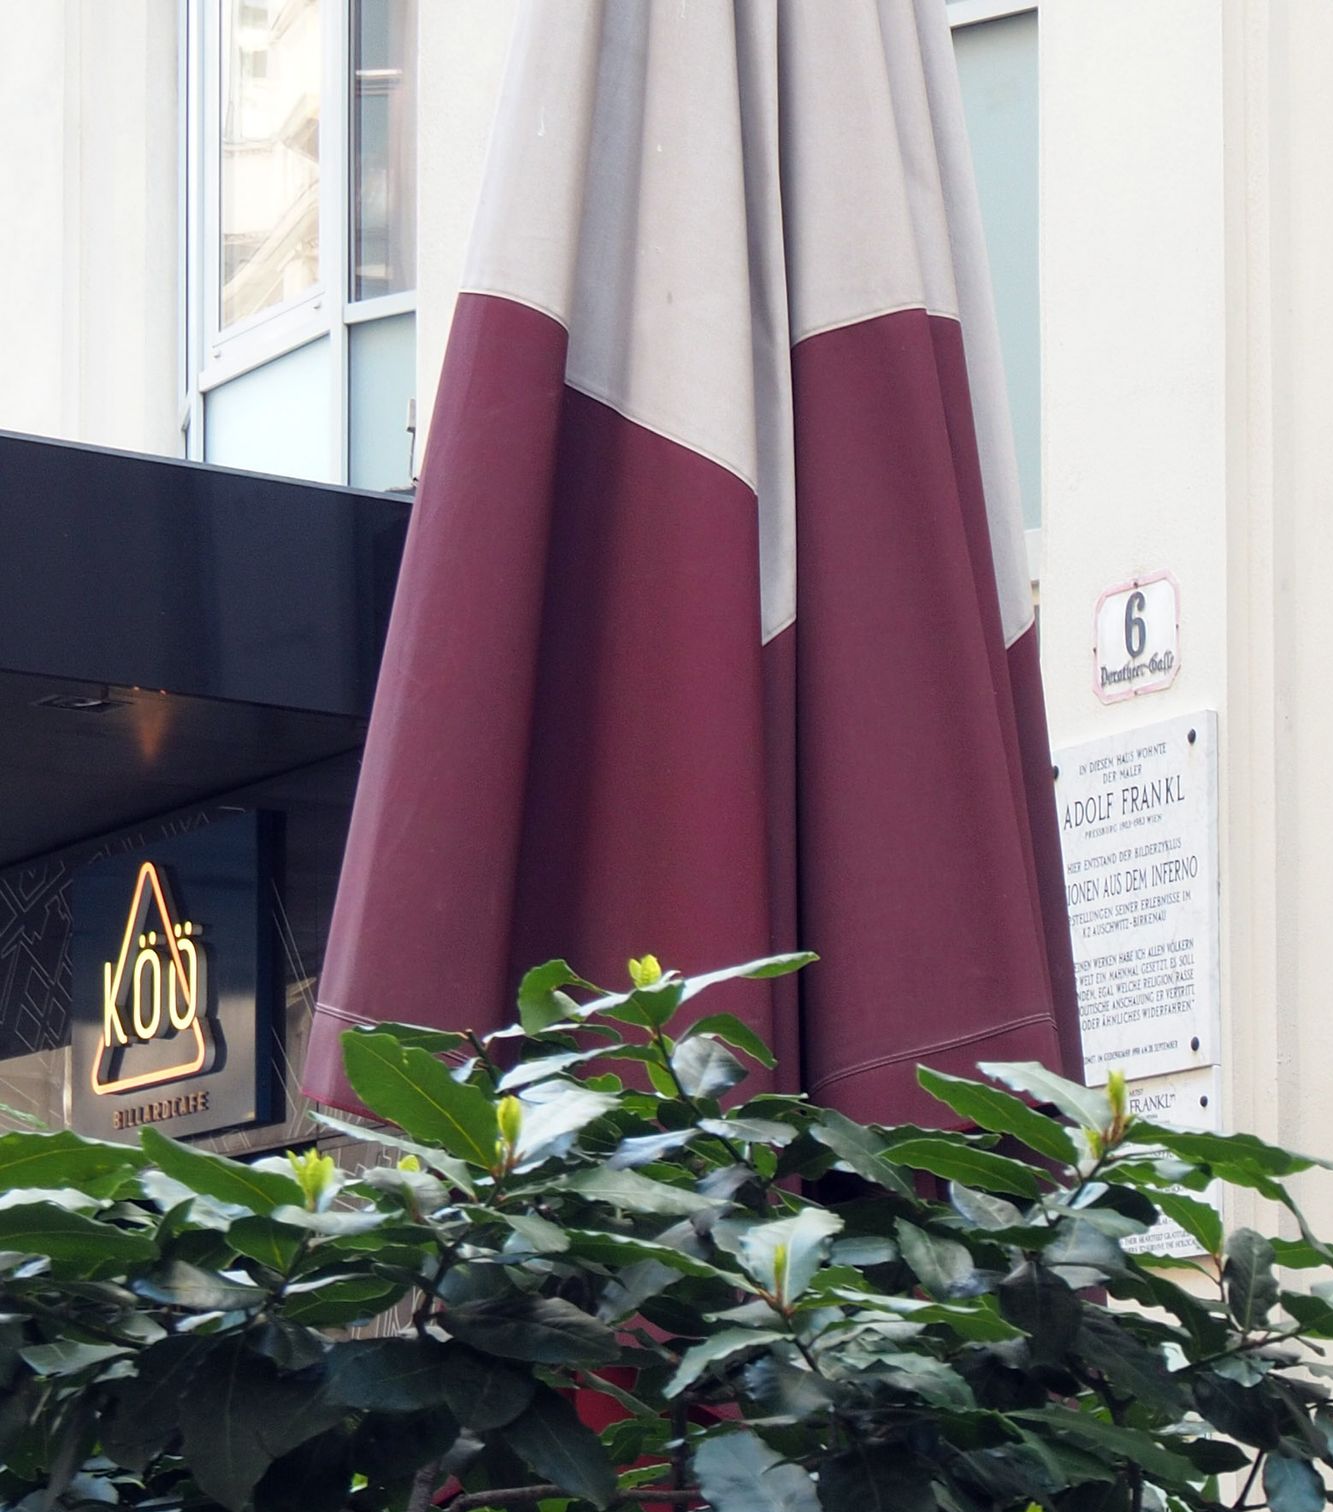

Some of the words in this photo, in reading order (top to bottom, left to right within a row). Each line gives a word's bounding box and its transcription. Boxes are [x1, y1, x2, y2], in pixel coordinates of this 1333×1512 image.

[1124, 591, 1146, 658] 6
[1079, 765, 1087, 776] IN
[1089, 757, 1114, 773] DIESEM
[1117, 751, 1134, 765] HAUS
[1136, 742, 1167, 759] WOHNTE
[1103, 771, 1117, 784] DER
[1120, 764, 1142, 778] MALER
[1063, 792, 1114, 831] ADOLF
[1122, 775, 1185, 815] FRANKL
[1067, 862, 1081, 874] HIER
[1084, 853, 1117, 871] ENTSTAND
[1119, 849, 1132, 862] DER
[1135, 837, 1182, 858] BILDERZYKLUS
[1067, 878, 1099, 906] IONEN
[1103, 872, 1122, 898] AUS
[1125, 867, 1148, 892] DEM
[1151, 855, 1198, 887] INFERNO
[1114, 901, 1139, 916] SEINER
[1141, 893, 1180, 911] ERLEBNISSE
[1182, 889, 1192, 901] IM
[1079, 974, 1094, 986] WELT
[1095, 972, 1107, 984] EIN
[1109, 965, 1138, 982] MAHNMAL
[1178, 953, 1195, 966] SOLL
[1093, 955, 1117, 968] WERKEN
[1118, 950, 1134, 963] HABE
[1135, 949, 1146, 960] ICH
[1148, 944, 1165, 957] ALLEN
[104, 921, 198, 1047] KÖÖ
[1098, 985, 1113, 998] EGAL
[1116, 979, 1141, 993] WELCHE
[1175, 969, 1194, 982] RASSE
[1112, 991, 1154, 1009] ANSCHAUUNG
[1156, 990, 1164, 1001] ER
[1082, 1018, 1100, 1032] ODER
[1102, 1009, 1141, 1027] ÄHNLICHES
